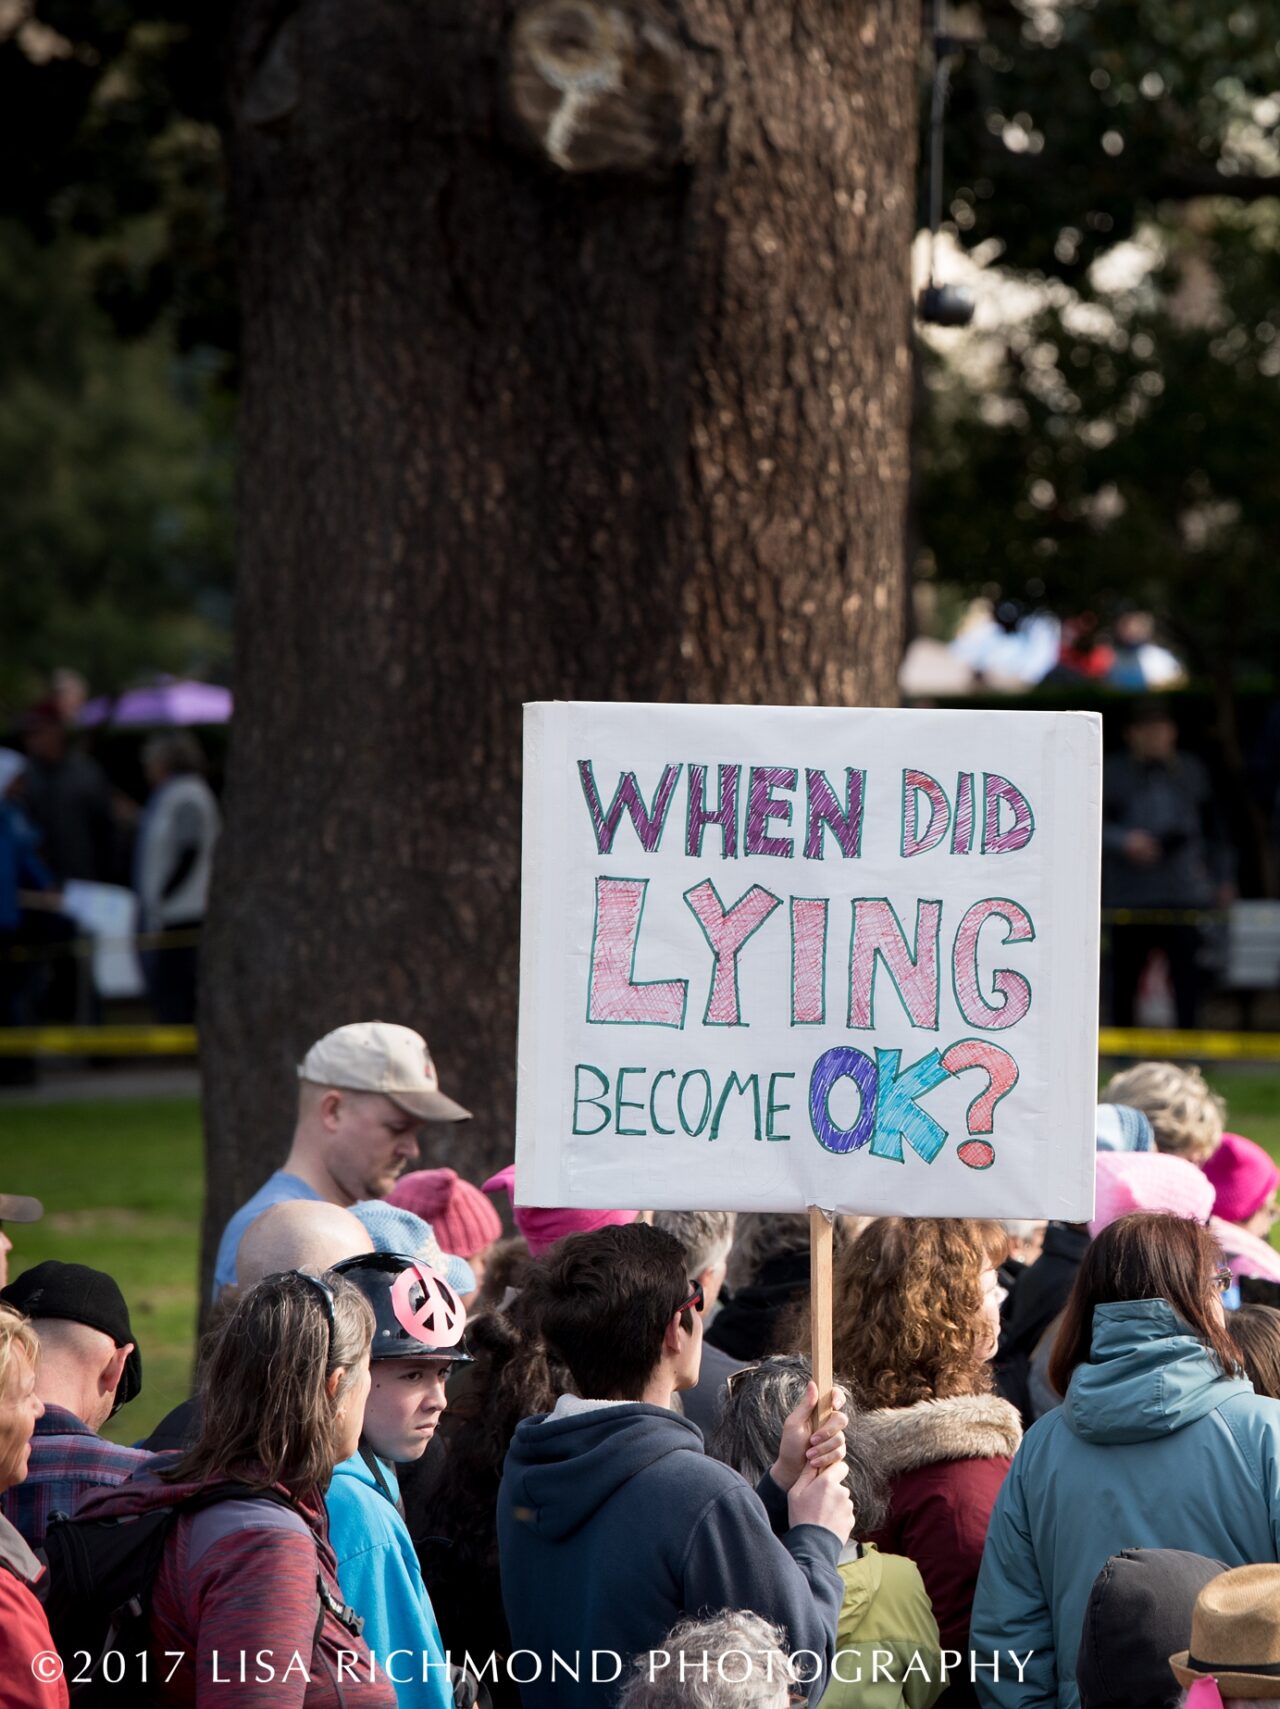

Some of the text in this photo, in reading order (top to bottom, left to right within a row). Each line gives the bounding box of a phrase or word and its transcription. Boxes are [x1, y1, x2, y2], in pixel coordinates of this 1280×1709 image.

[577, 760, 1035, 859] WHEN DID
[586, 875, 1036, 1031] LYING
[572, 1037, 1019, 1169] BECOME OK?
